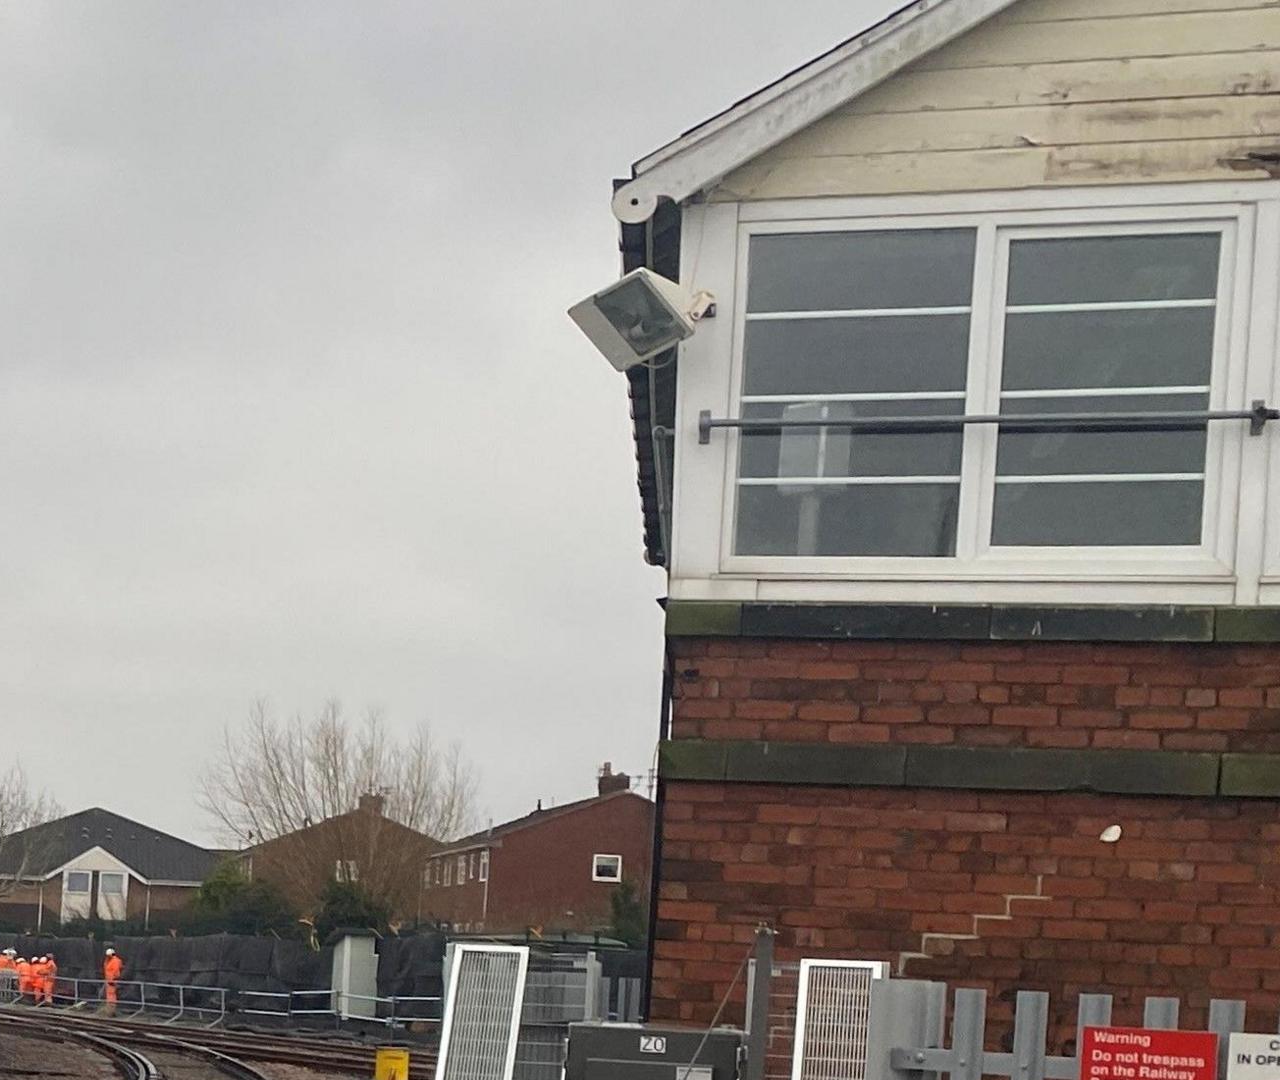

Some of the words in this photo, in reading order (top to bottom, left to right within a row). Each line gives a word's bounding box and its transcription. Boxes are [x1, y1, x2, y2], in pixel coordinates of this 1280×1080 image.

[1093, 1031, 1151, 1047] Warning
[1092, 1049, 1112, 1062] Do
[1115, 1052, 1138, 1063] not
[1142, 1053, 1205, 1068] trespass
[1237, 1053, 1251, 1064] IN
[1091, 1066, 1109, 1076] on
[1113, 1065, 1135, 1077] the
